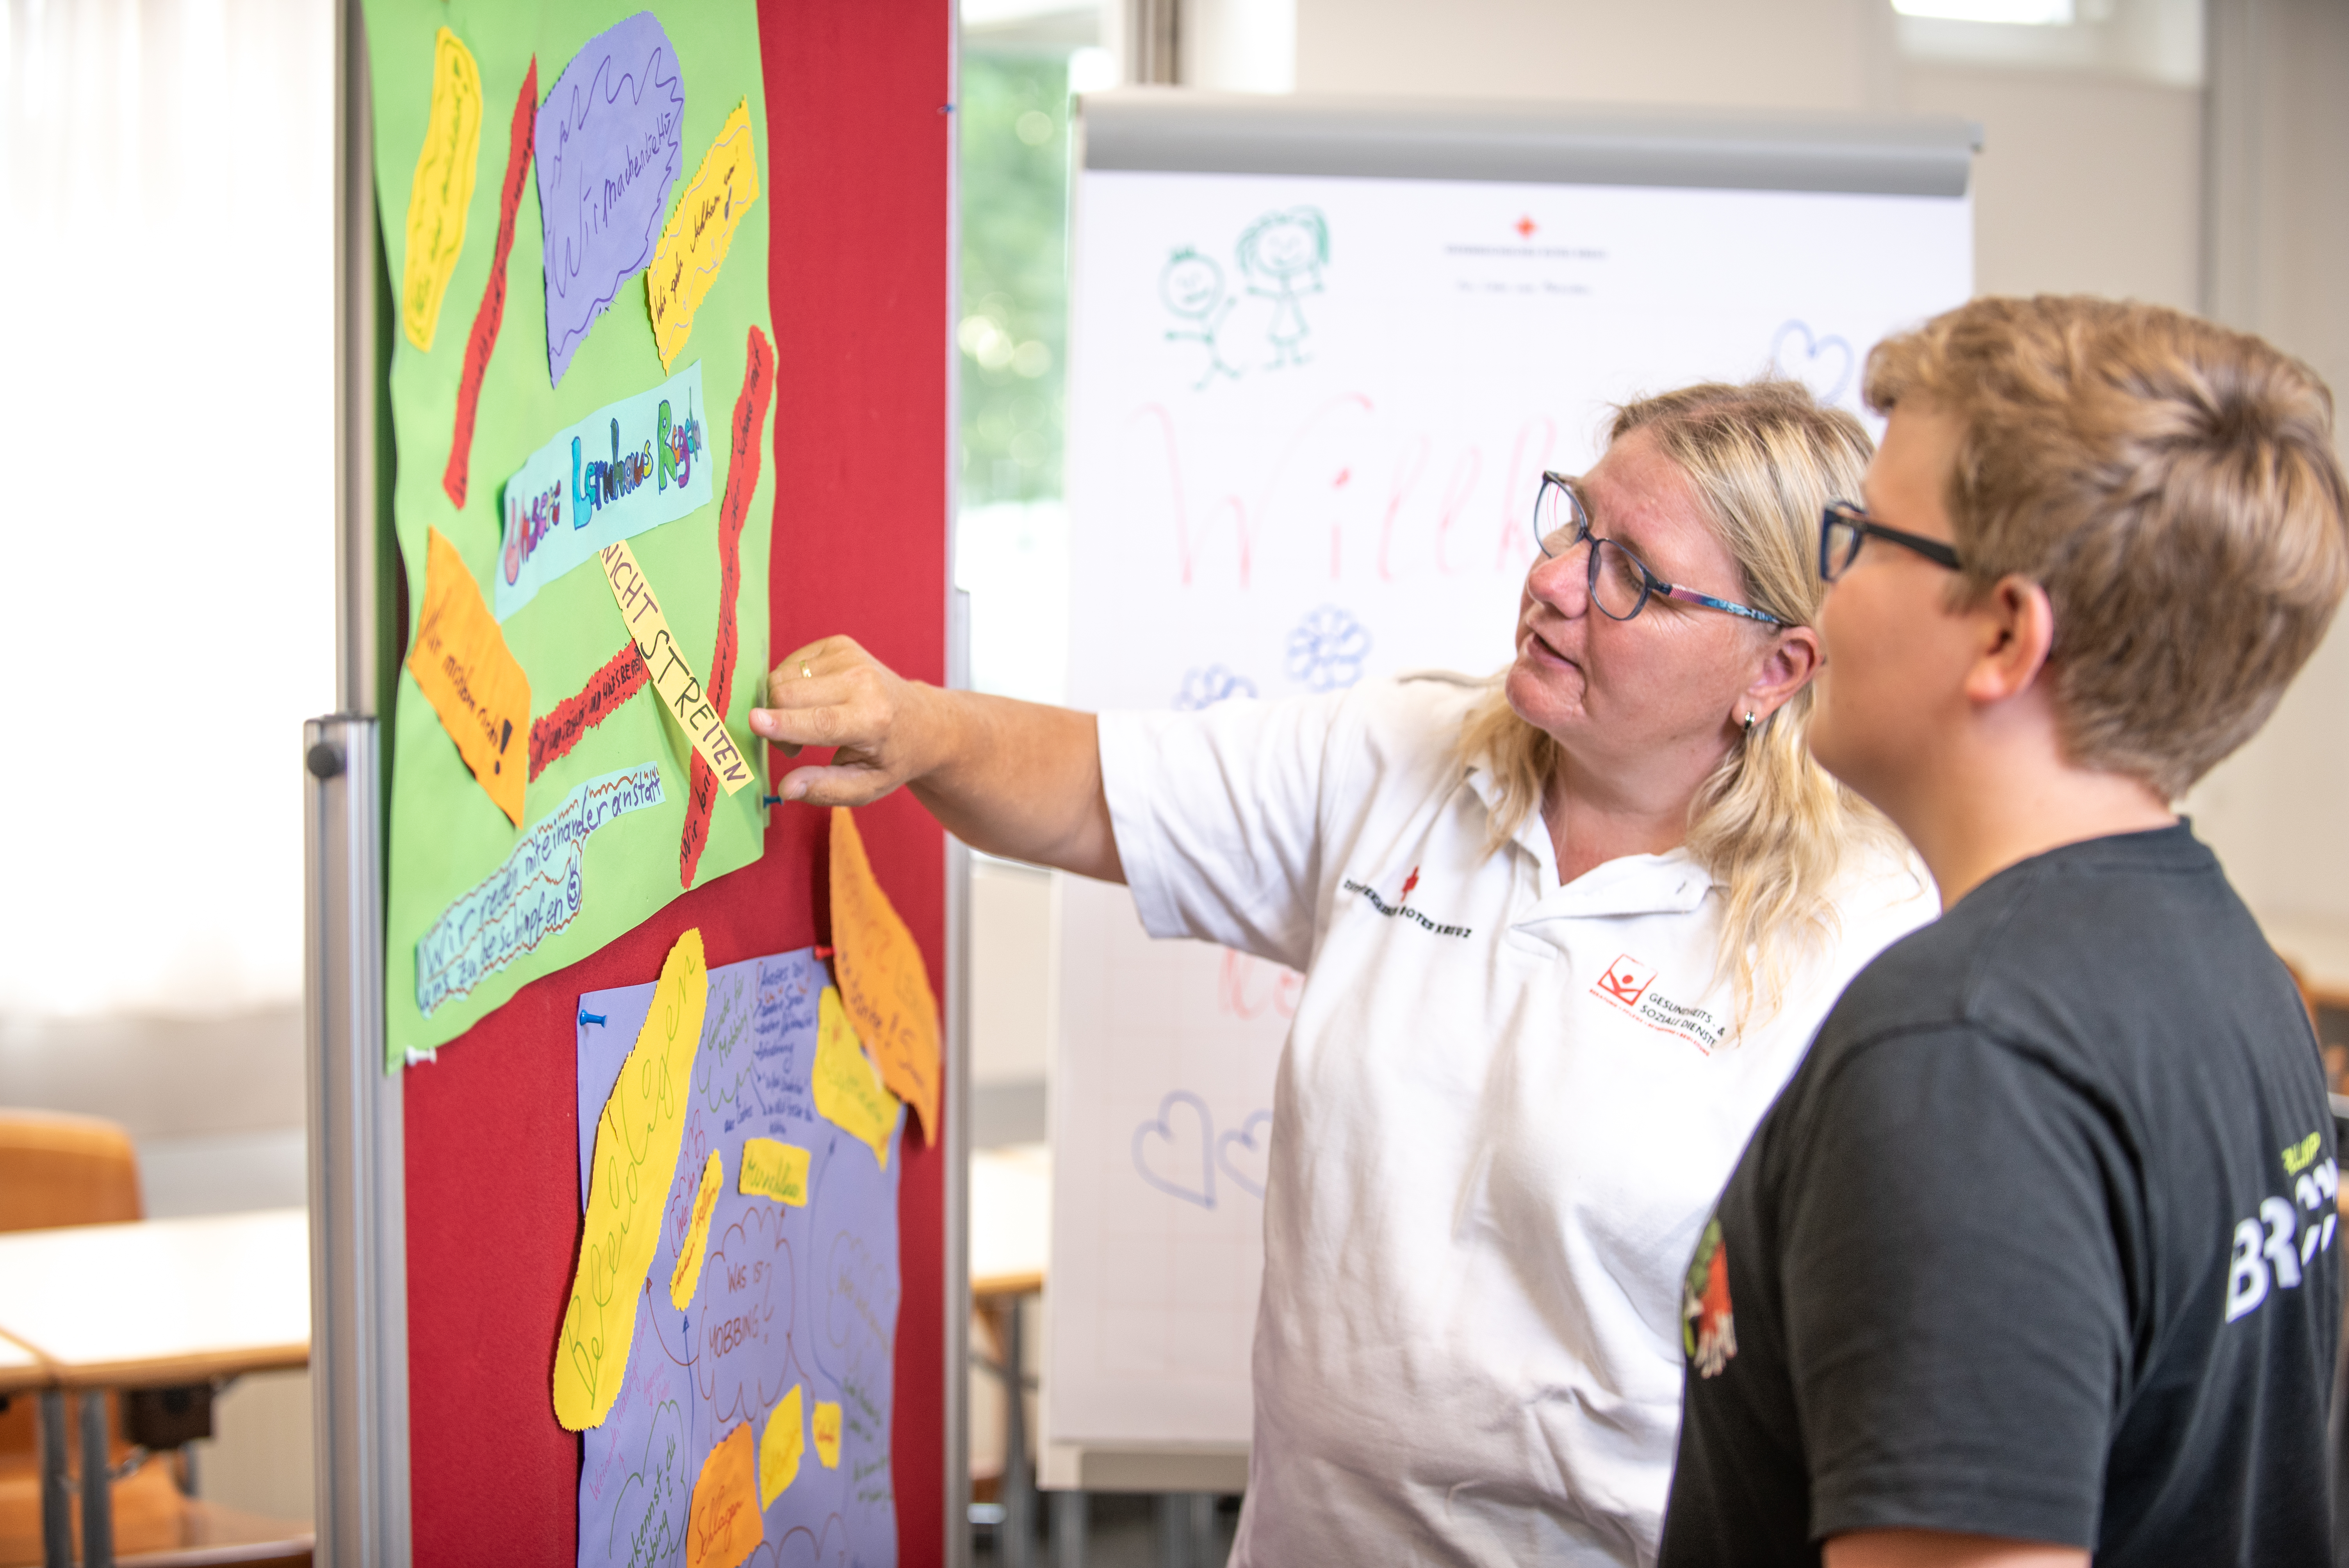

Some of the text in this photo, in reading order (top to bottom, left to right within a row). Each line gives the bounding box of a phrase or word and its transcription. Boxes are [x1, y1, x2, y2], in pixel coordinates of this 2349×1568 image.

[571, 417, 653, 530] Lernhaus
[658, 386, 702, 495] Regeln
[602, 543, 747, 782] NICHT STREITEN
[525, 784, 608, 877] miteinander
[681, 821, 698, 864] Wir
